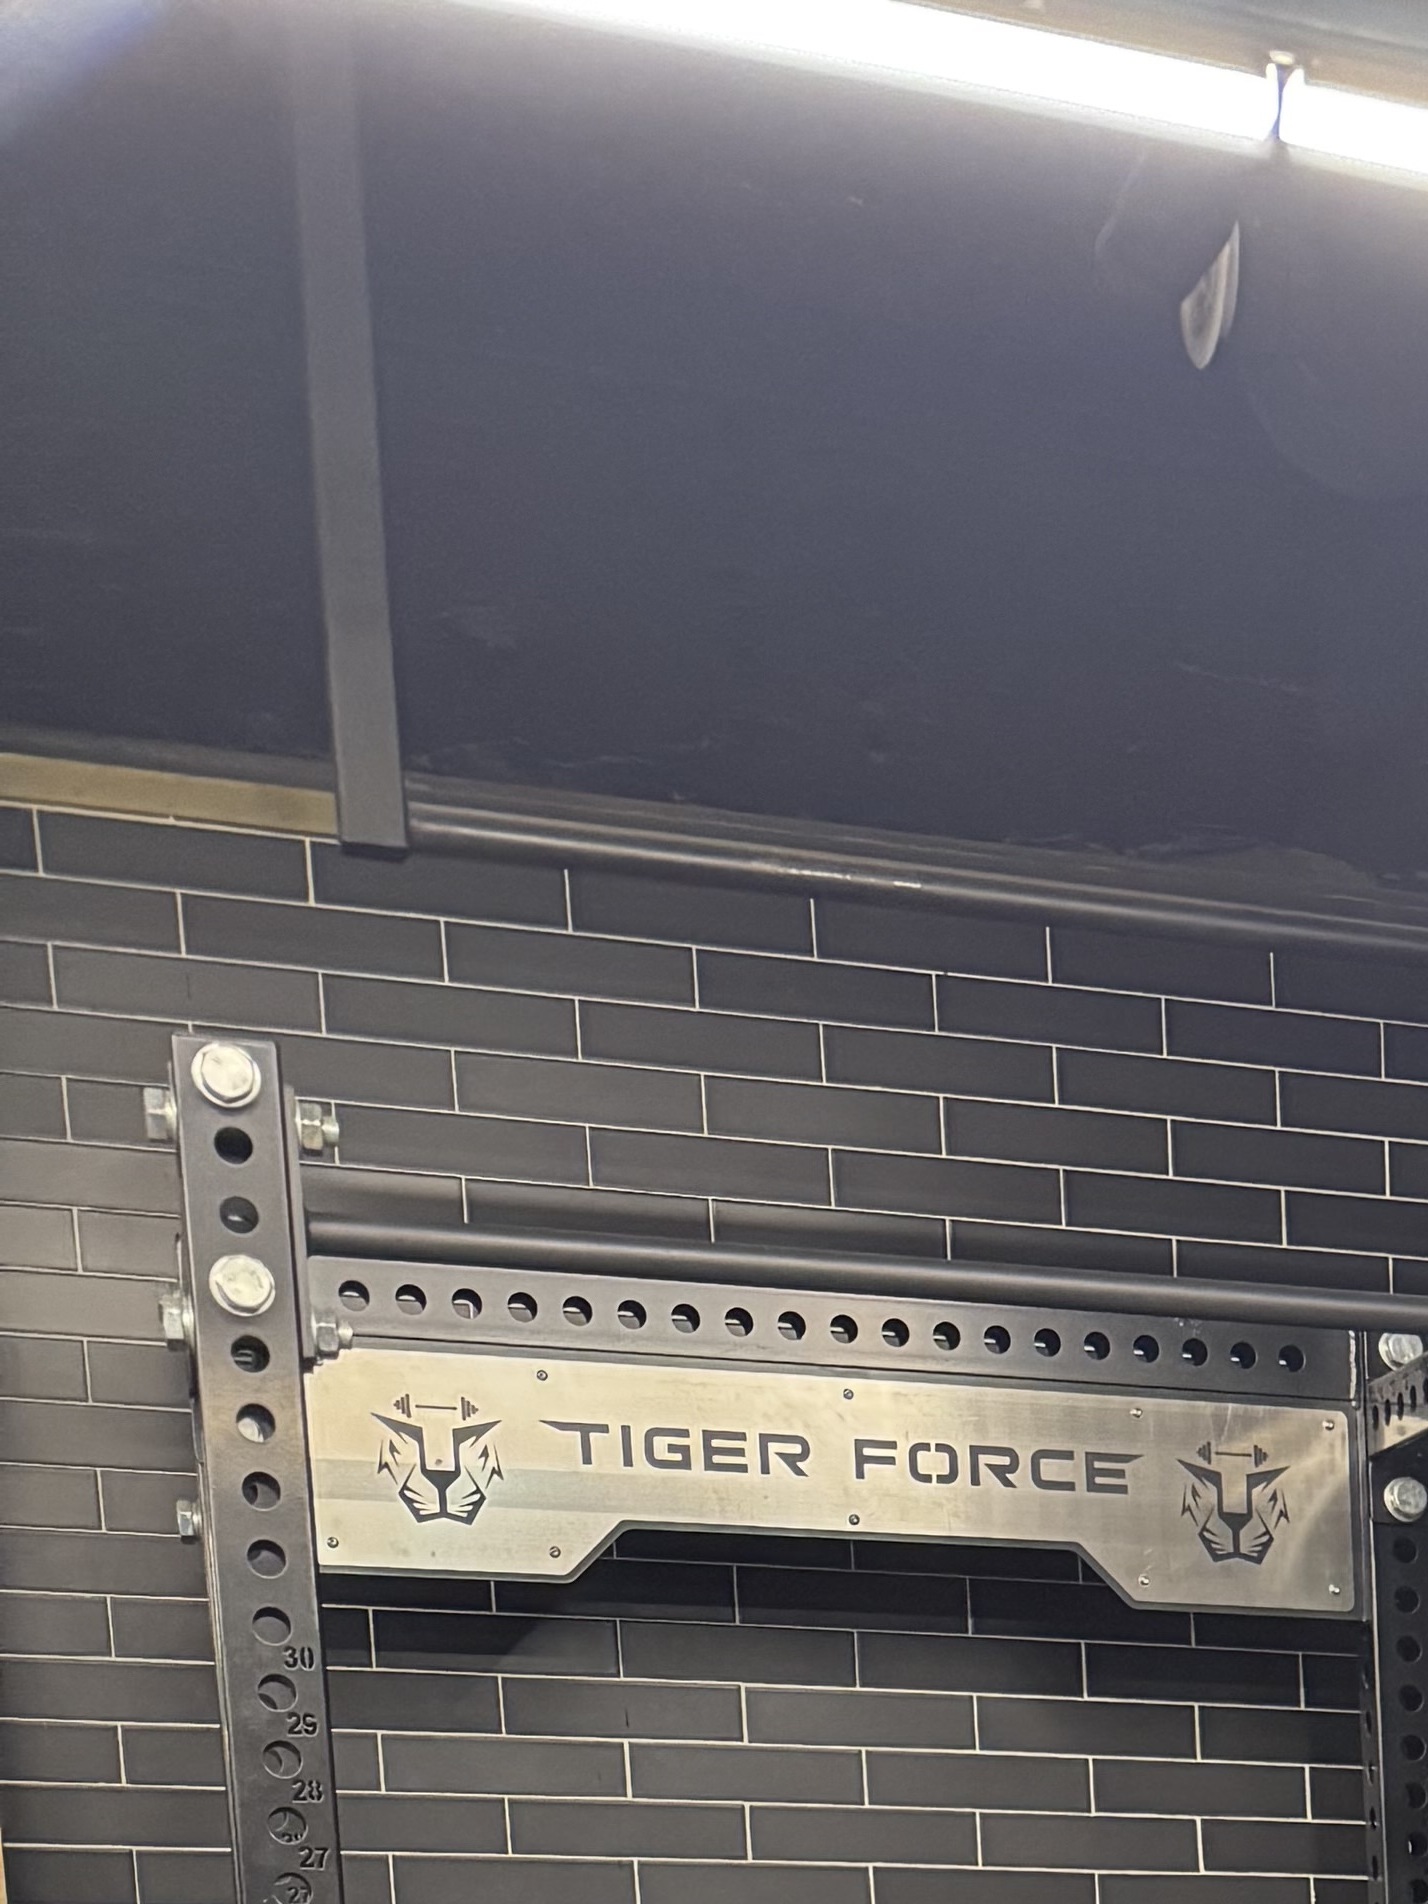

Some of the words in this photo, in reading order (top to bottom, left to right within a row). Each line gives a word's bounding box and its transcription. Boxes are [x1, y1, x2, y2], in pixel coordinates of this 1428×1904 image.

[538, 1418, 812, 1479] TIGER
[853, 1437, 1145, 1496] FORCE
[284, 1646, 314, 1671] 30
[292, 1780, 324, 1804] 28
[298, 1846, 329, 1870] 27
